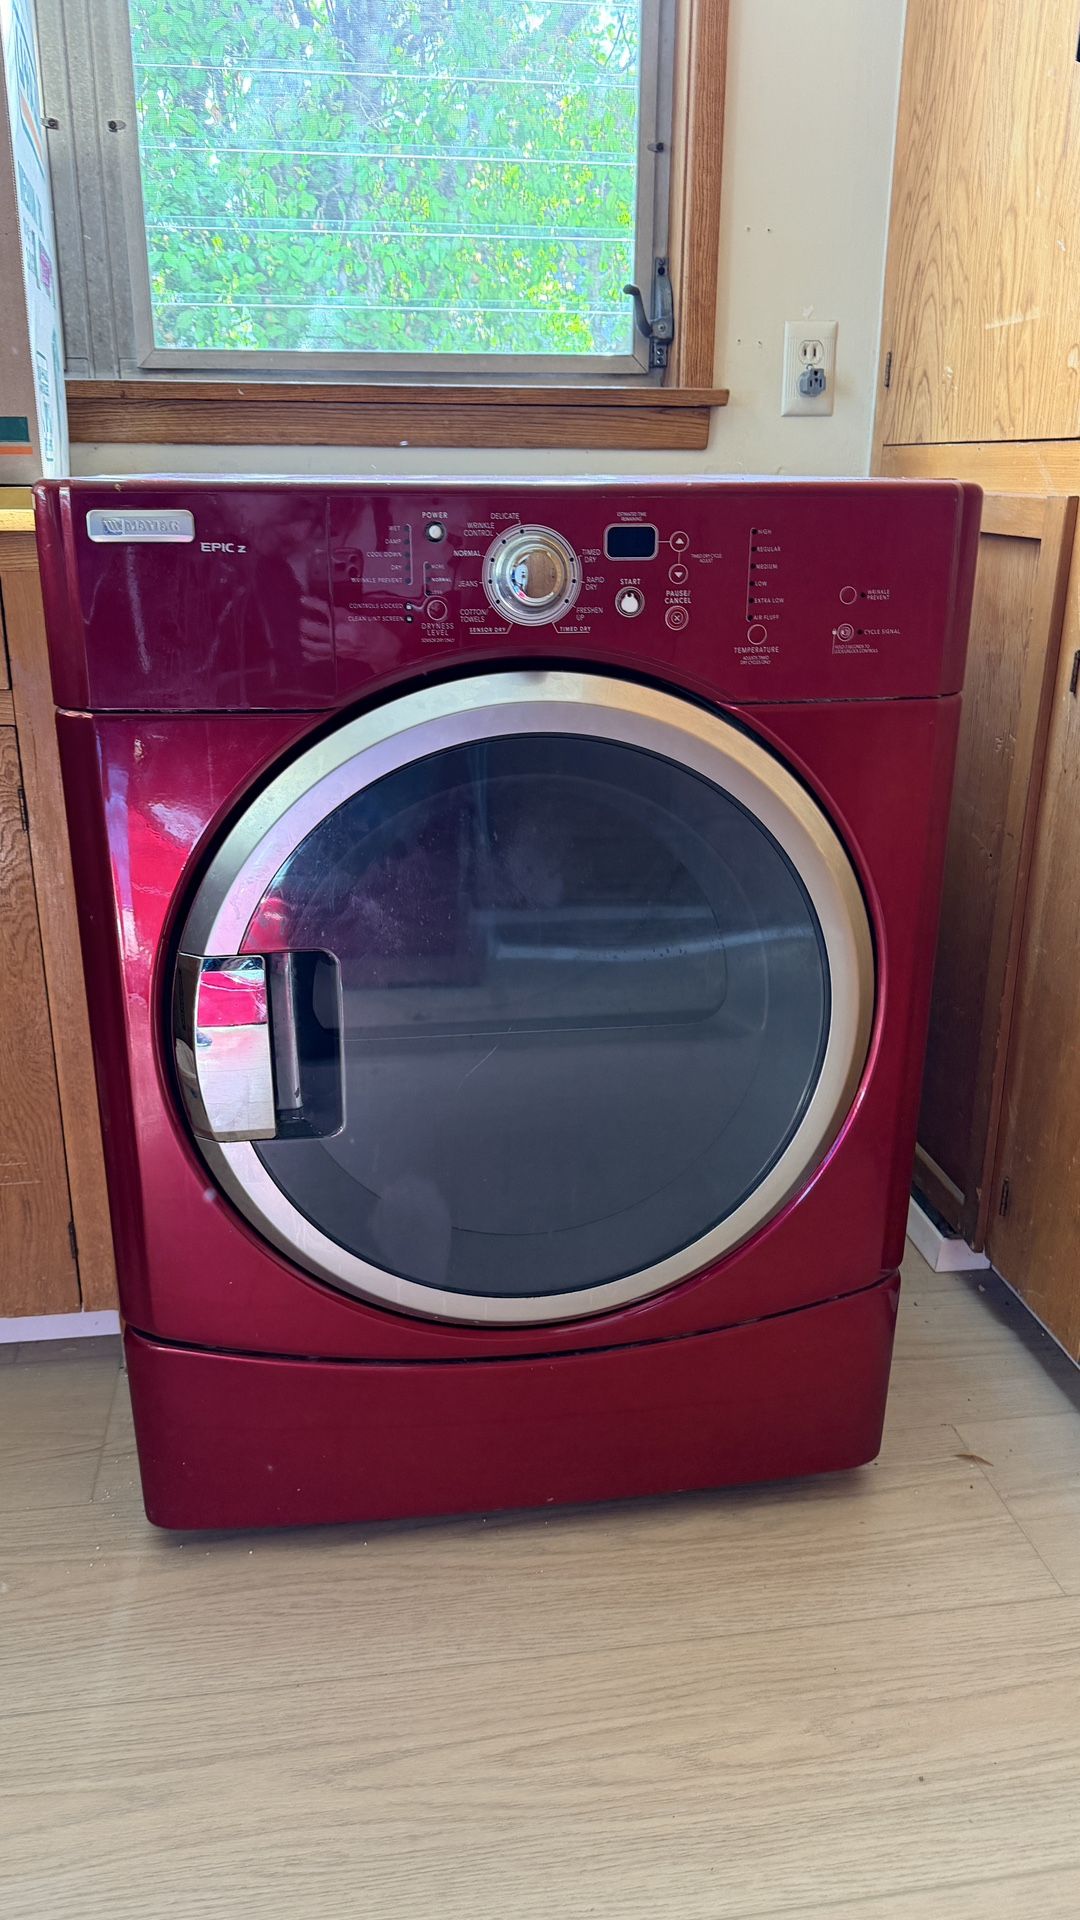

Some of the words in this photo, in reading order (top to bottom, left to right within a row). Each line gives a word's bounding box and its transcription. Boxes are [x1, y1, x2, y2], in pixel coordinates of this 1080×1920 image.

[421, 511, 448, 519] POWER
[490, 512, 520, 520] DELICATE
[463, 529, 494, 537] CONTROL
[200, 542, 235, 553] EPIC
[581, 548, 601, 556] TIMED
[458, 580, 479, 588] JEANS
[586, 576, 605, 584] RAPID
[585, 583, 597, 591] DRY
[665, 589, 691, 597] PAUSE/
[664, 597, 692, 605] CANCEL
[576, 606, 603, 614] FRESHEN
[460, 615, 485, 623] TOWELS
[575, 614, 585, 622] UP
[421, 622, 455, 630] DRYNESS
[426, 629, 449, 637] LEVEL
[734, 646, 780, 654] TEMPERATURE
